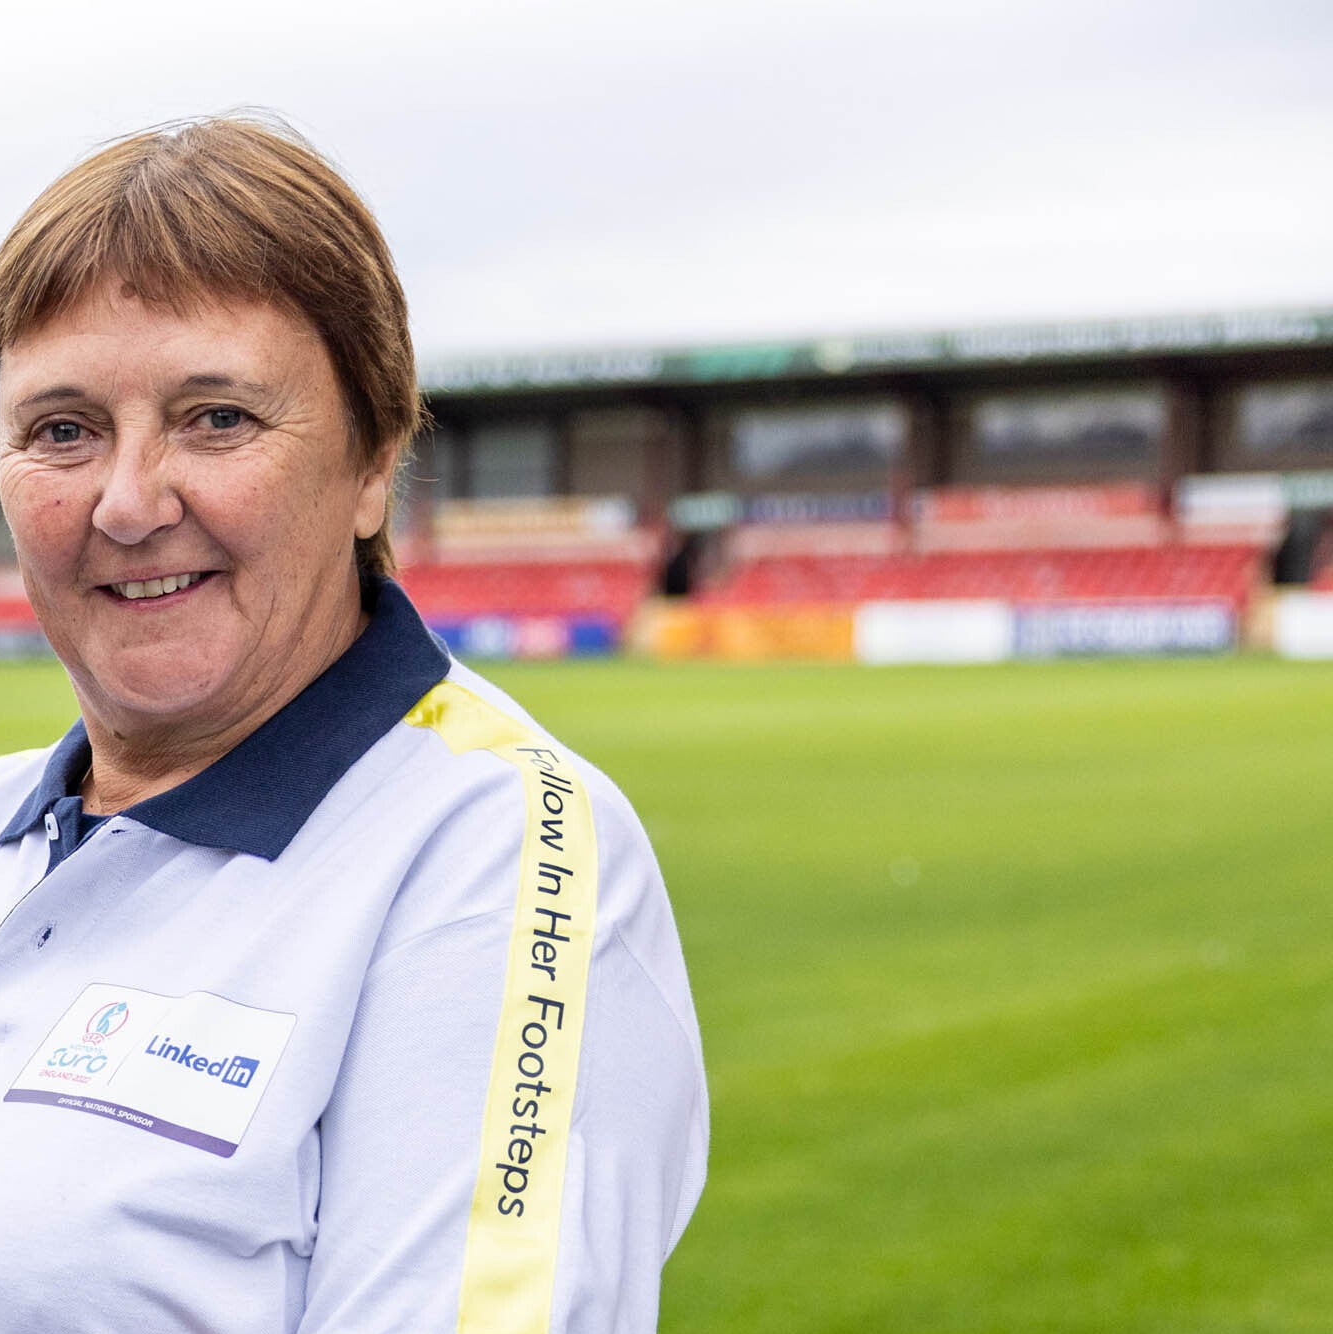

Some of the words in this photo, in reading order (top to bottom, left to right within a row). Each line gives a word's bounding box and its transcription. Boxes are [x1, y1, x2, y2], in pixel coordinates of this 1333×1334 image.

[516, 748, 574, 852] Follow
[537, 861, 573, 896] In
[531, 908, 570, 982] Her
[57, 1097, 83, 1108] OFFICIAL
[84, 1101, 117, 1116] NATIONAL
[117, 1109, 154, 1128] SPONSOR
[497, 995, 565, 1219] Footsteps
